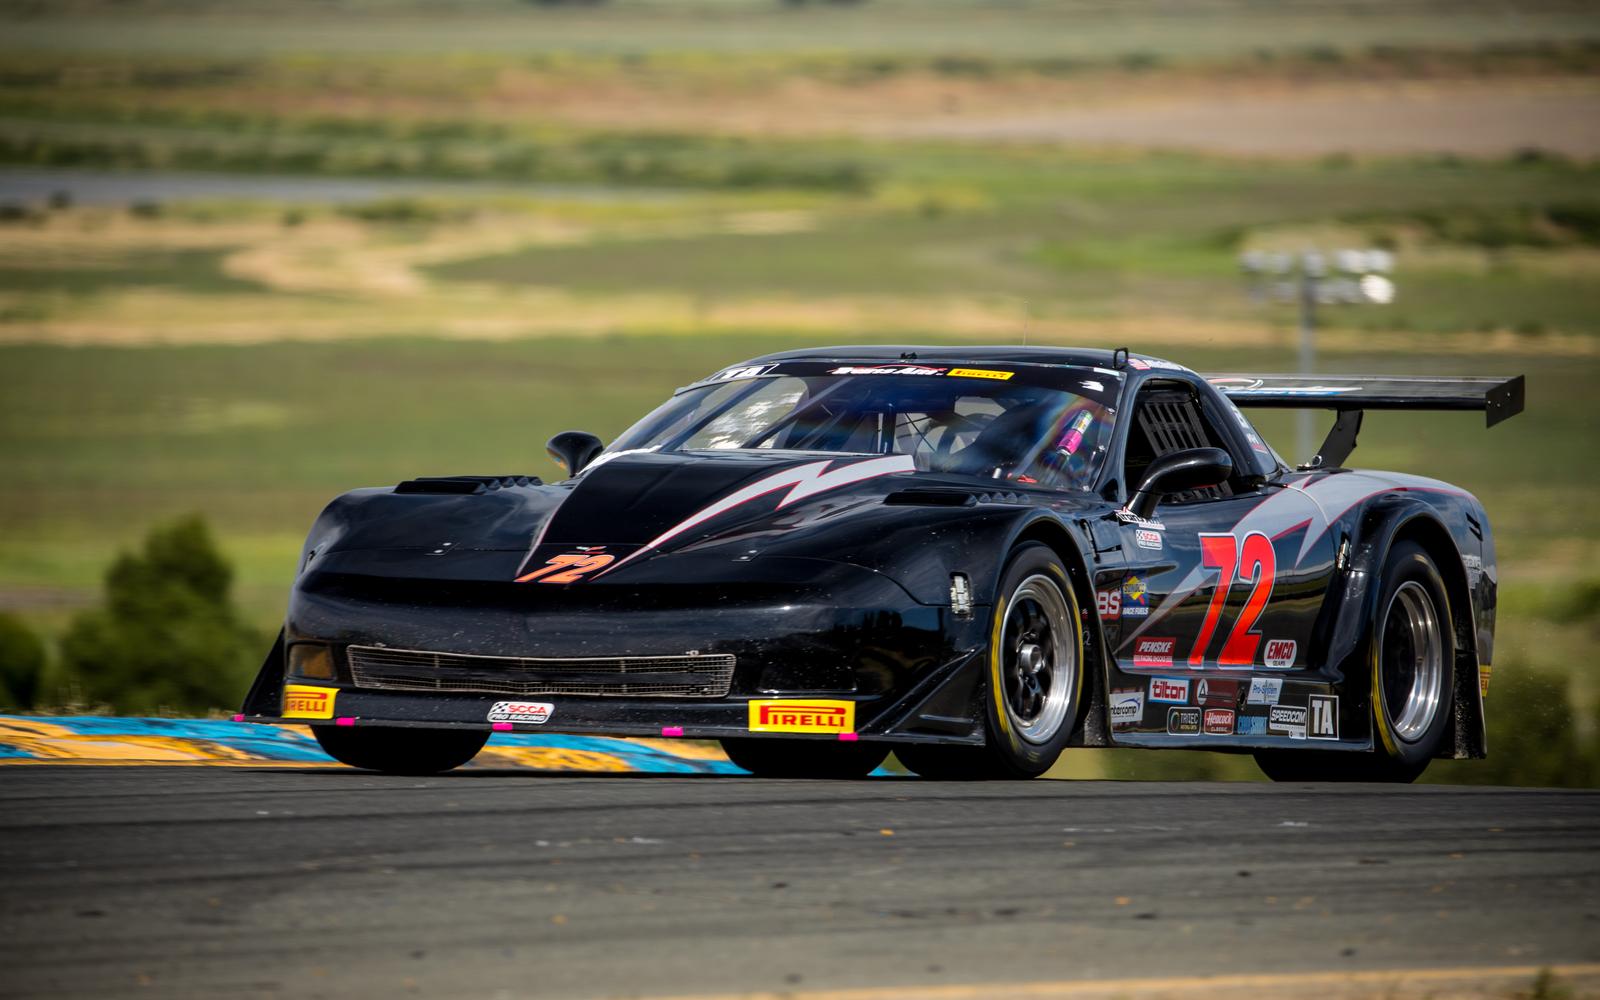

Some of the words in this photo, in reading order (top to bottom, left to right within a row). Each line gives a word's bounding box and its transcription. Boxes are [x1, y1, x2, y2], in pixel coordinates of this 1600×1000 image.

[719, 366, 763, 381] TA
[955, 370, 1007, 378] PIRELLI
[513, 554, 615, 584] 72
[1187, 530, 1276, 669] 72
[1122, 607, 1136, 615] RACE
[1135, 607, 1149, 615] FUELS
[1139, 641, 1173, 653] PENSKE
[1267, 642, 1294, 659] EMCO
[1152, 681, 1186, 700] tilton
[508, 705, 546, 713] SCCA
[760, 705, 846, 727] PIRELLI
[1271, 709, 1306, 723] SPEEDCOM
[491, 713, 509, 721] PRO
[509, 714, 546, 722] RACING
[1206, 712, 1233, 726] Heacock
[1312, 700, 1334, 734] TA
